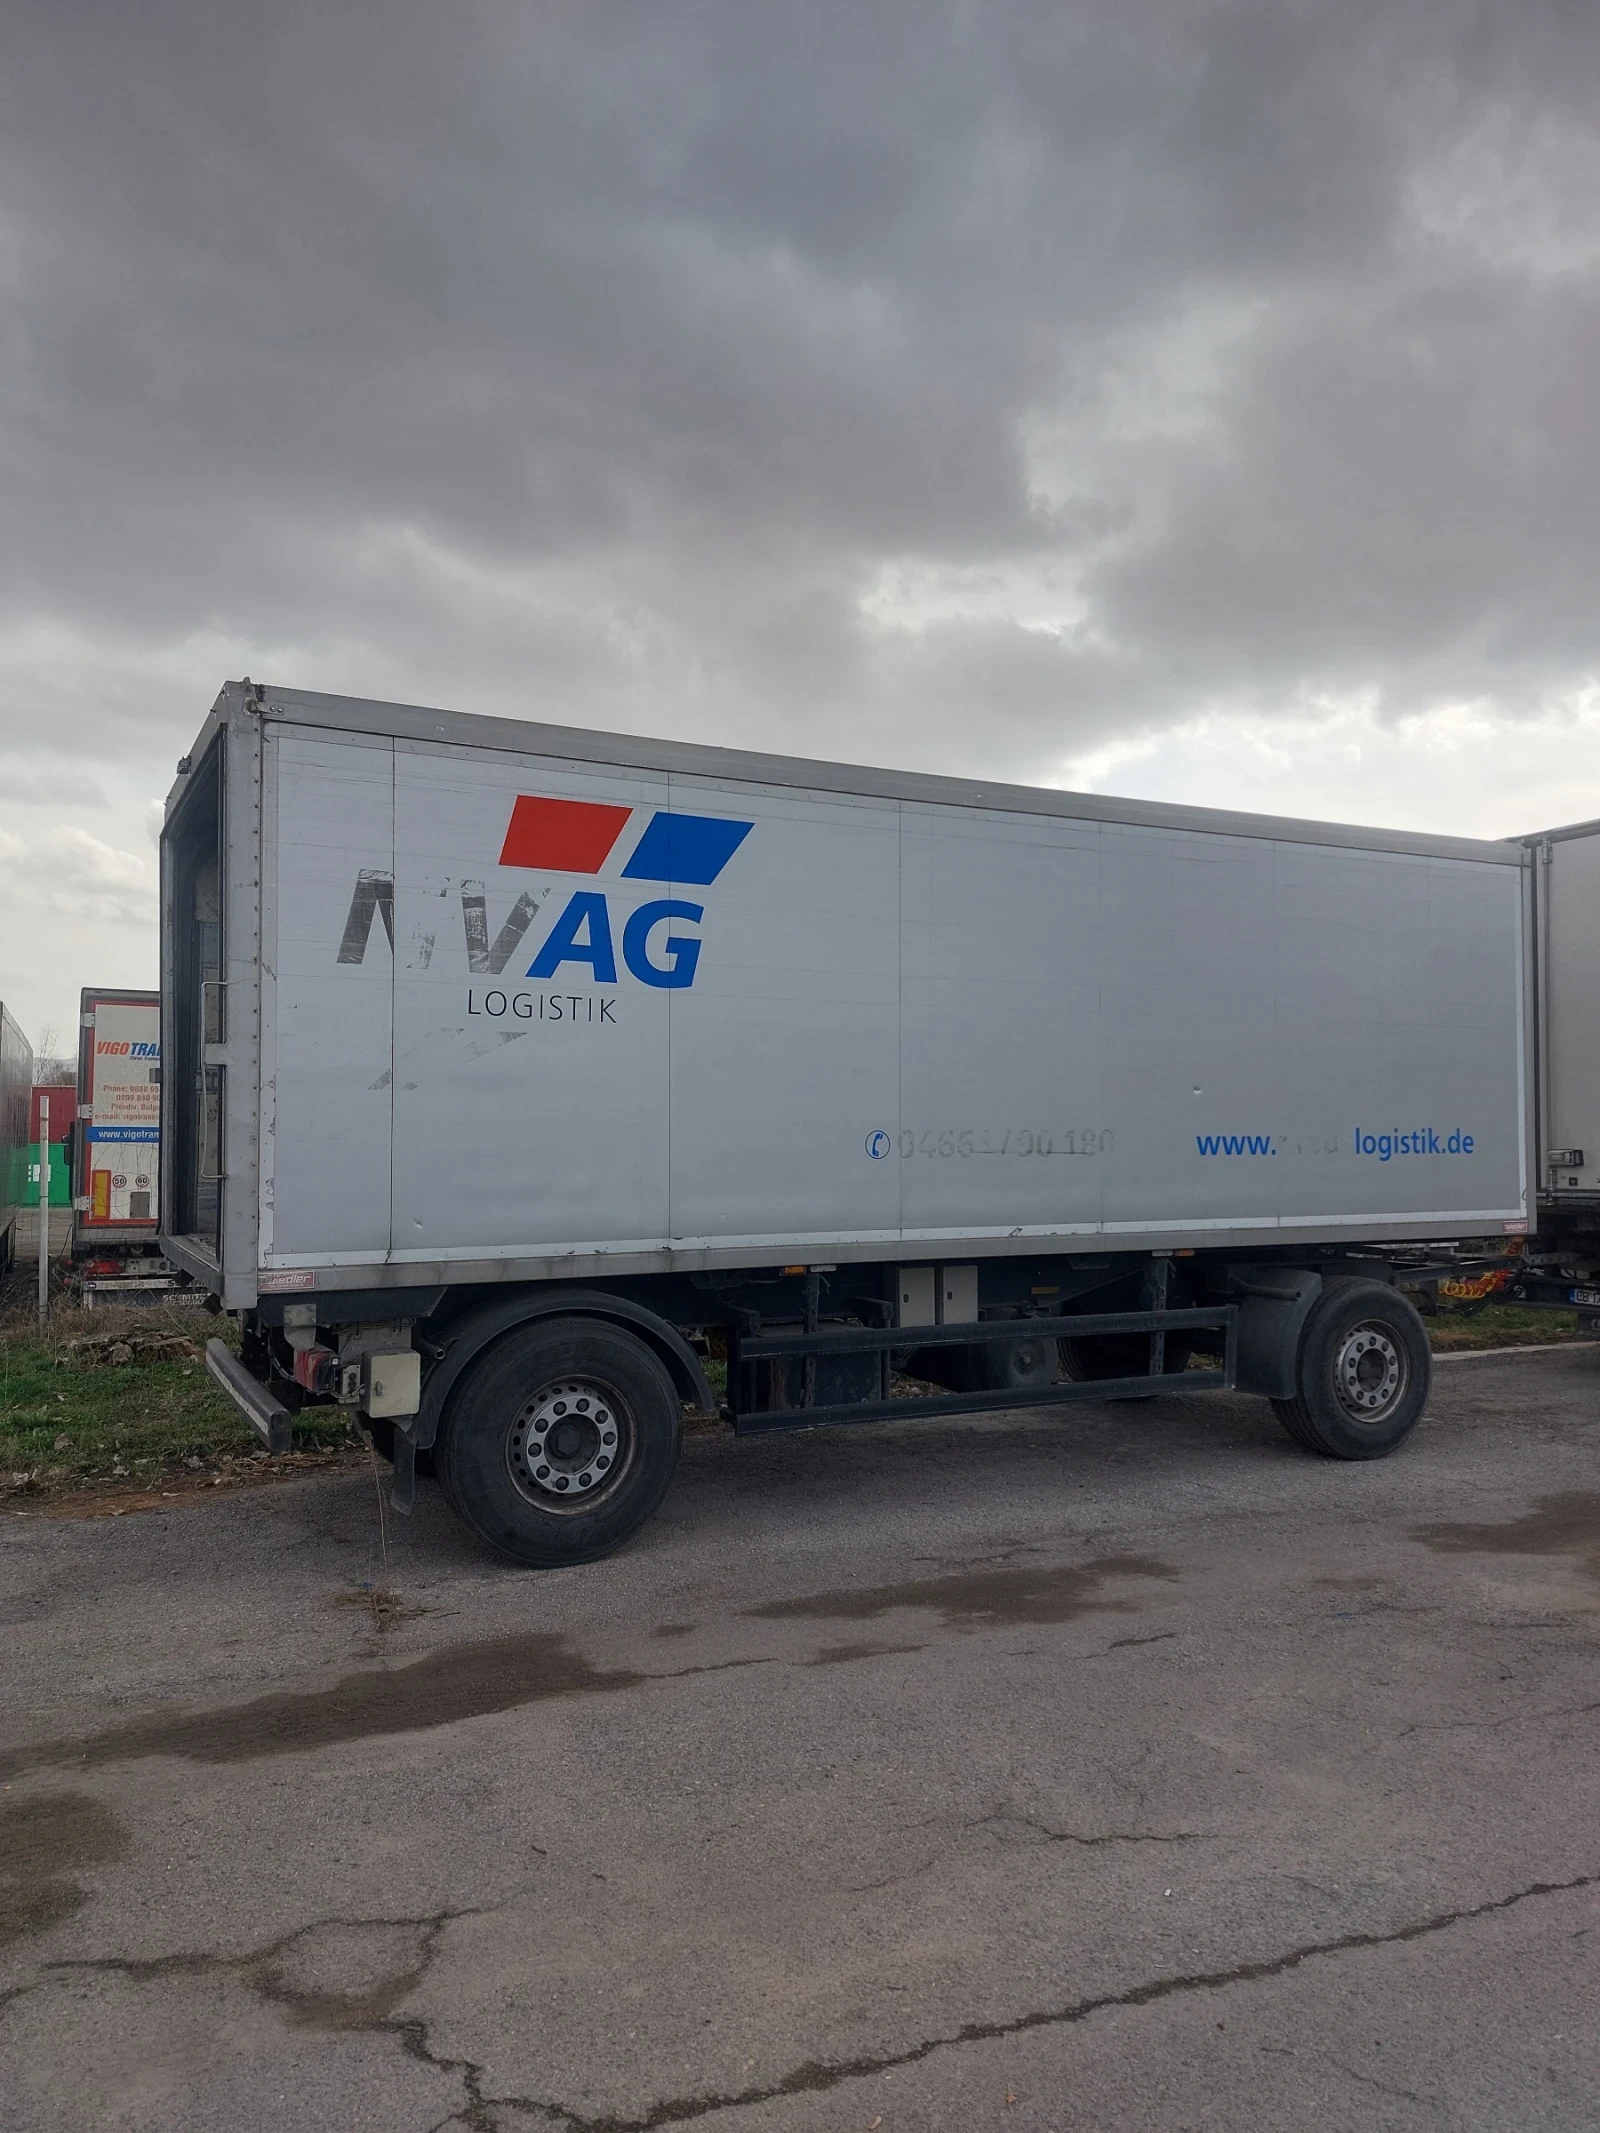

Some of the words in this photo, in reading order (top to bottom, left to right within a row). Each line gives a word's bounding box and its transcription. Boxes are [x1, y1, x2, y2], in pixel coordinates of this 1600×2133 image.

[467, 988, 617, 1024] LOGISTIK
[103, 1084, 128, 1093] Phone:
[111, 1102, 139, 1112] Plovdiv,
[94, 1112, 121, 1120] e-mail:
[114, 1177, 125, 1185] 50
